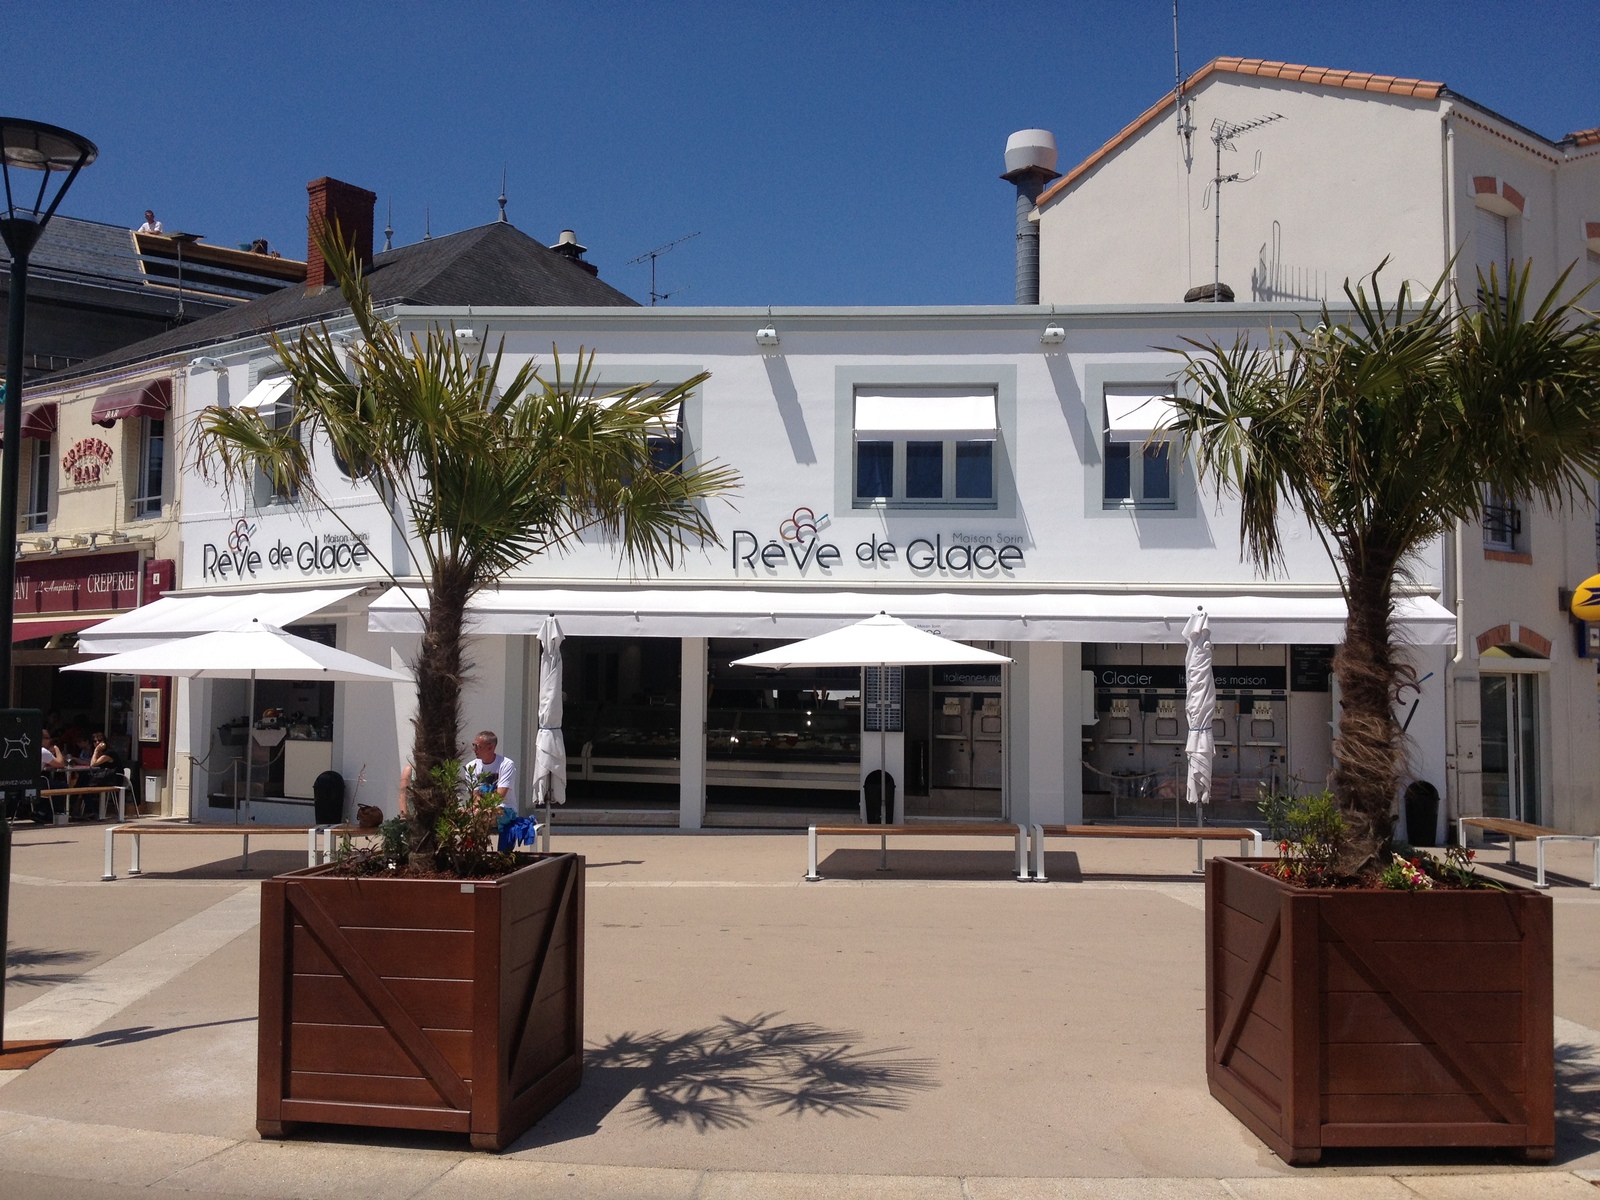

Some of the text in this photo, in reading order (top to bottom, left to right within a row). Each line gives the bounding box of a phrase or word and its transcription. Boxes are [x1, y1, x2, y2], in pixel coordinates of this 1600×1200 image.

[105, 410, 119, 419] BAR
[74, 465, 101, 484] BAR
[323, 533, 349, 544] Maison
[951, 532, 1024, 544] Maison Sorin
[268, 539, 293, 565] de
[297, 535, 368, 570] Glace
[855, 533, 896, 562] de
[906, 533, 1024, 570] Glace
[87, 571, 135, 594] CREPERIE
[943, 672, 986, 683] Italiennes
[1102, 670, 1152, 685] Glacier
[1229, 675, 1267, 686] maison
